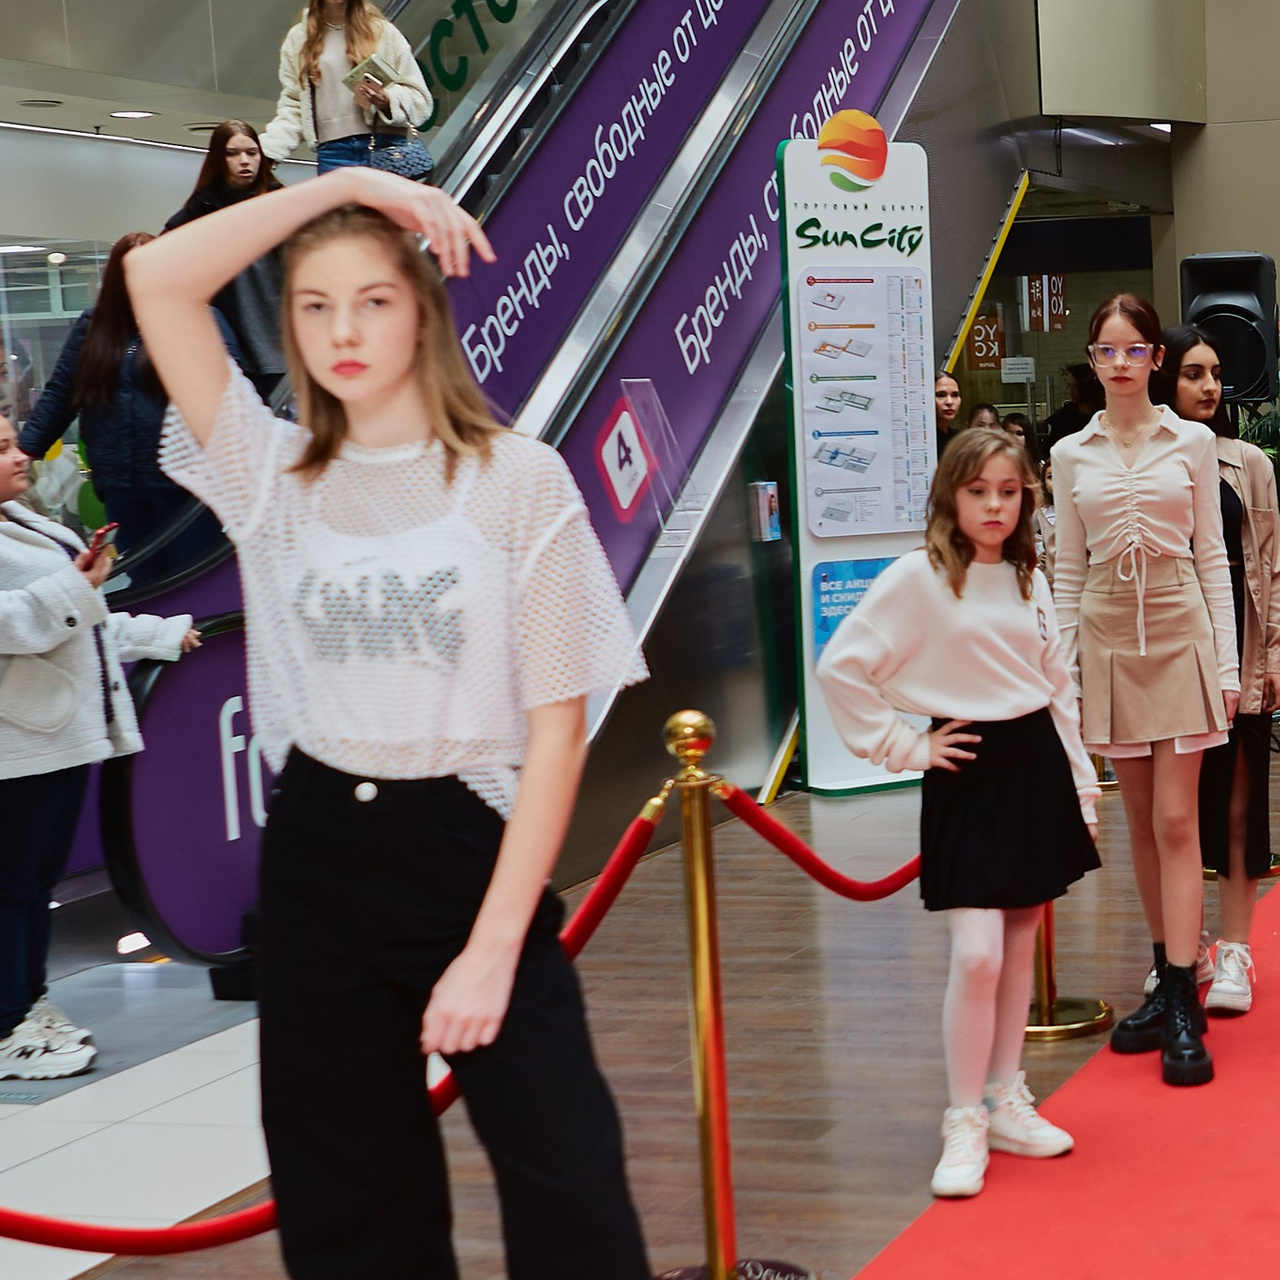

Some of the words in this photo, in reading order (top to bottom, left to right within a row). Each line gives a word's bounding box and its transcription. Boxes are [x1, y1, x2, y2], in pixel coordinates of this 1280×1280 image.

[461, 223, 571, 385] Бренды,
[563, 48, 676, 233] свободные
[672, 9, 699, 64] от
[794, 202, 868, 211] ТОРГОВЫЙ
[881, 204, 924, 212] ЦЕНТР
[674, 213, 768, 376] Бренды,
[617, 429, 633, 472] 4
[820, 580, 843, 591] ВСЕ
[820, 594, 830, 604] И
